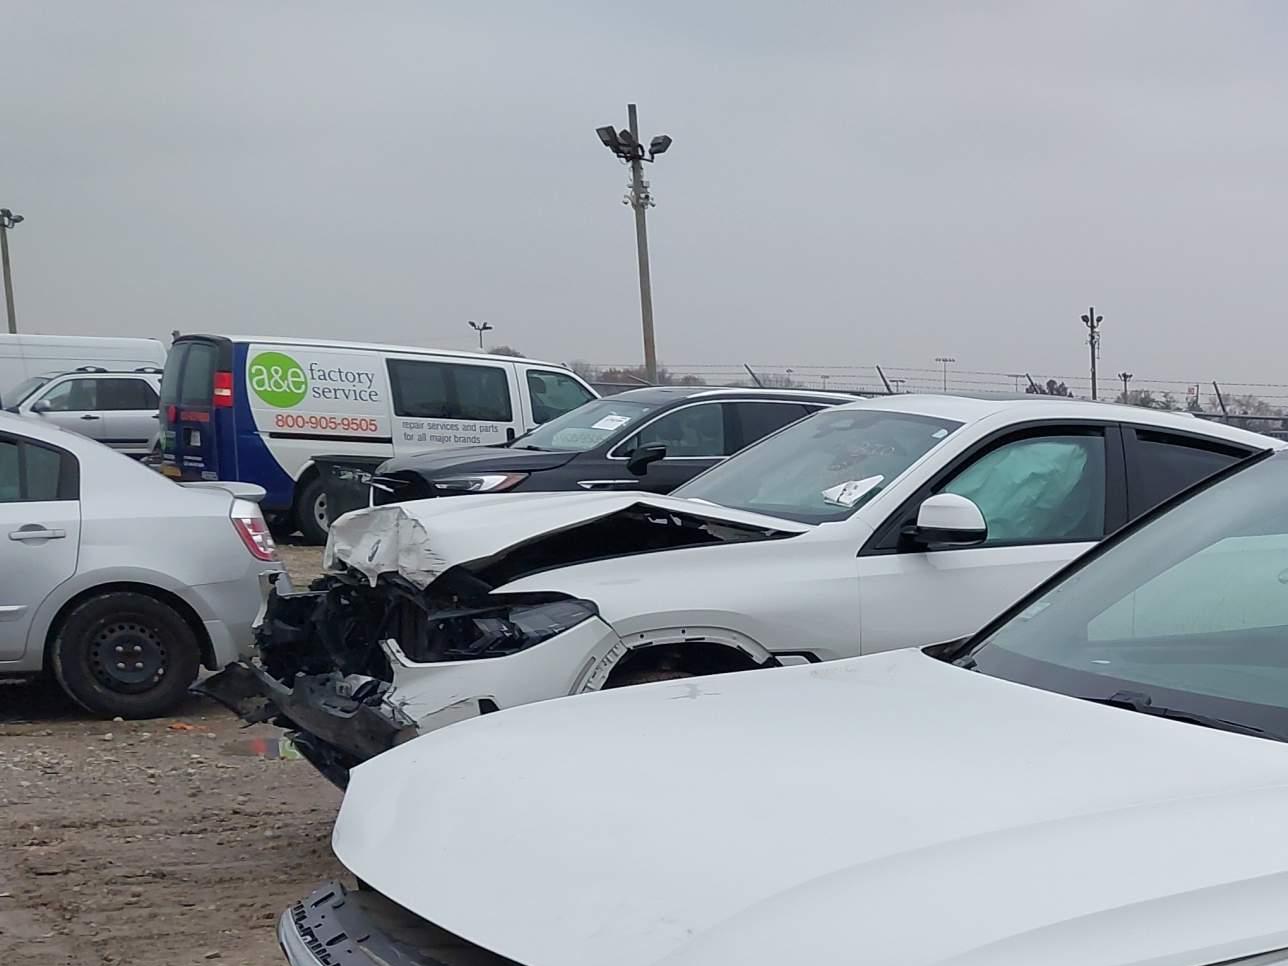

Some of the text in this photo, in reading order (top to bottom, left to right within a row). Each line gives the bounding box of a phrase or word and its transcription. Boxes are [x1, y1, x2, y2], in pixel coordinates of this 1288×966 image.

[251, 365, 306, 394] a&e
[309, 362, 376, 389] factory
[311, 384, 379, 402] service
[274, 414, 379, 432] 800-905-9505
[402, 421, 499, 433] repair services and parts
[403, 432, 481, 444] for all major brands
